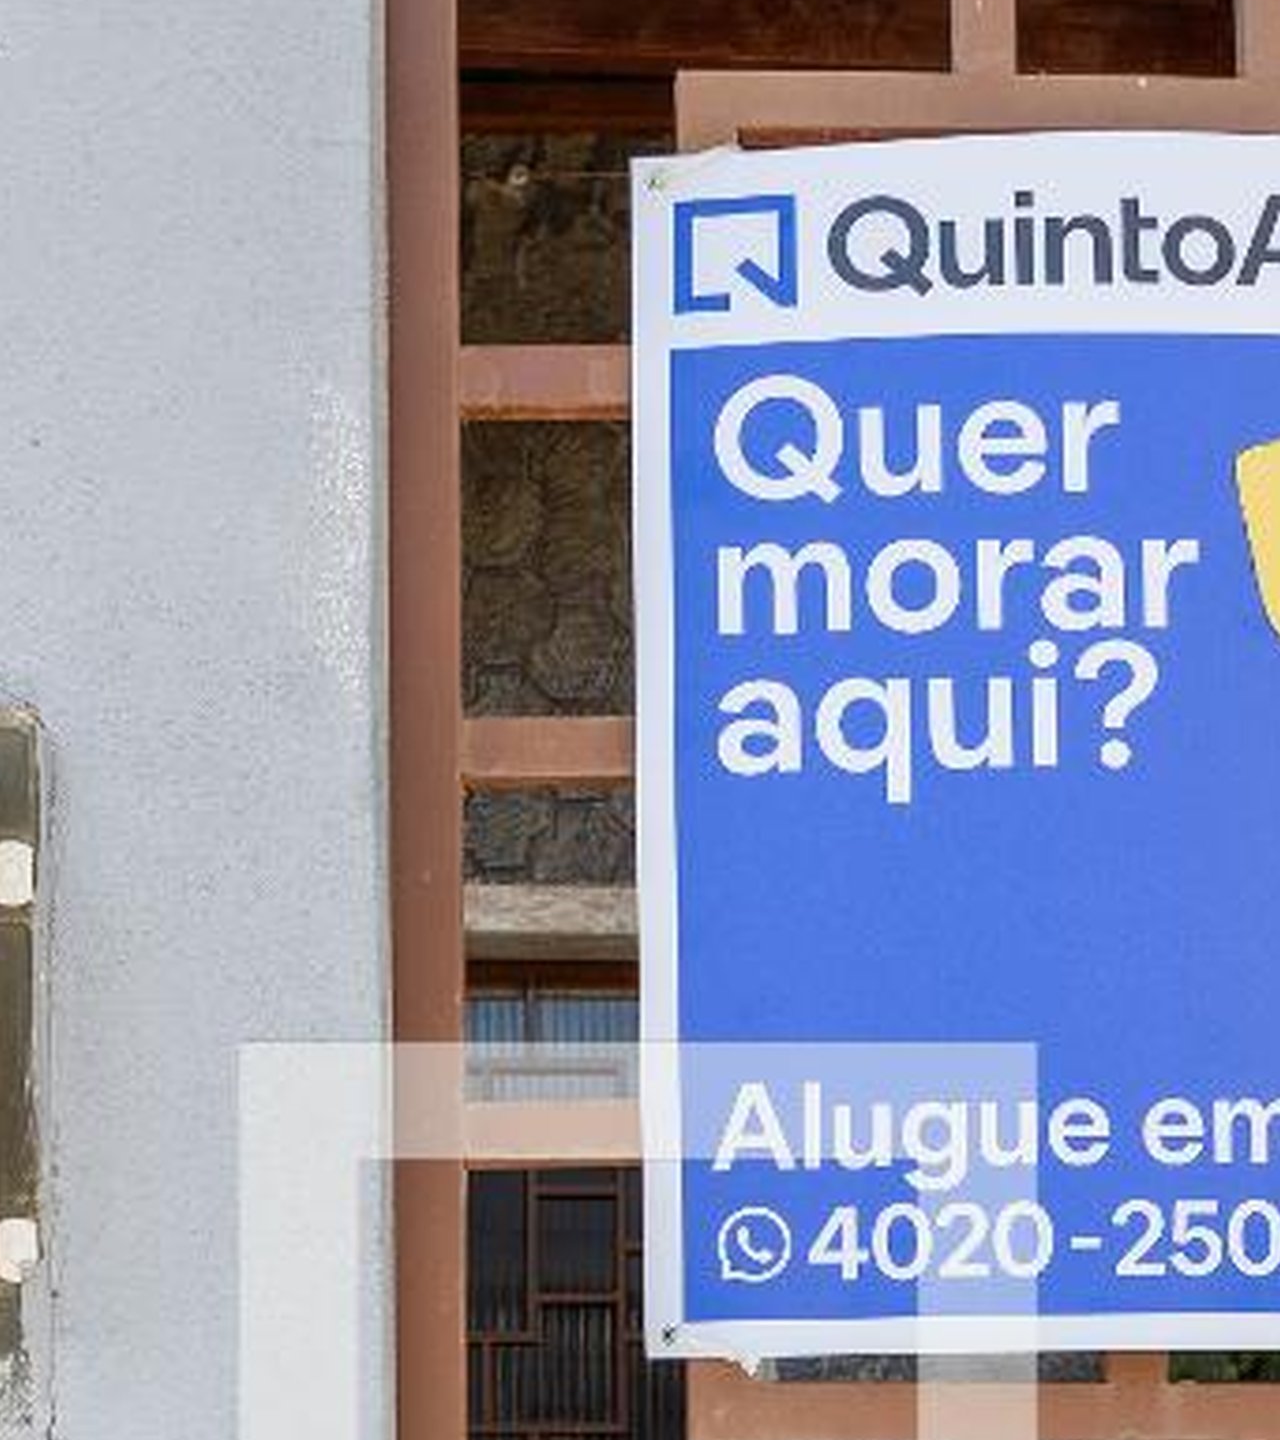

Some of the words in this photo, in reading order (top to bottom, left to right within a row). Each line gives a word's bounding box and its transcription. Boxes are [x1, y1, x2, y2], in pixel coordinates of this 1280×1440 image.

[715, 375, 1120, 502] Quer
[719, 536, 1199, 635] morar
[719, 642, 1159, 803] aqui?
[713, 1082, 1111, 1190] Alugue
